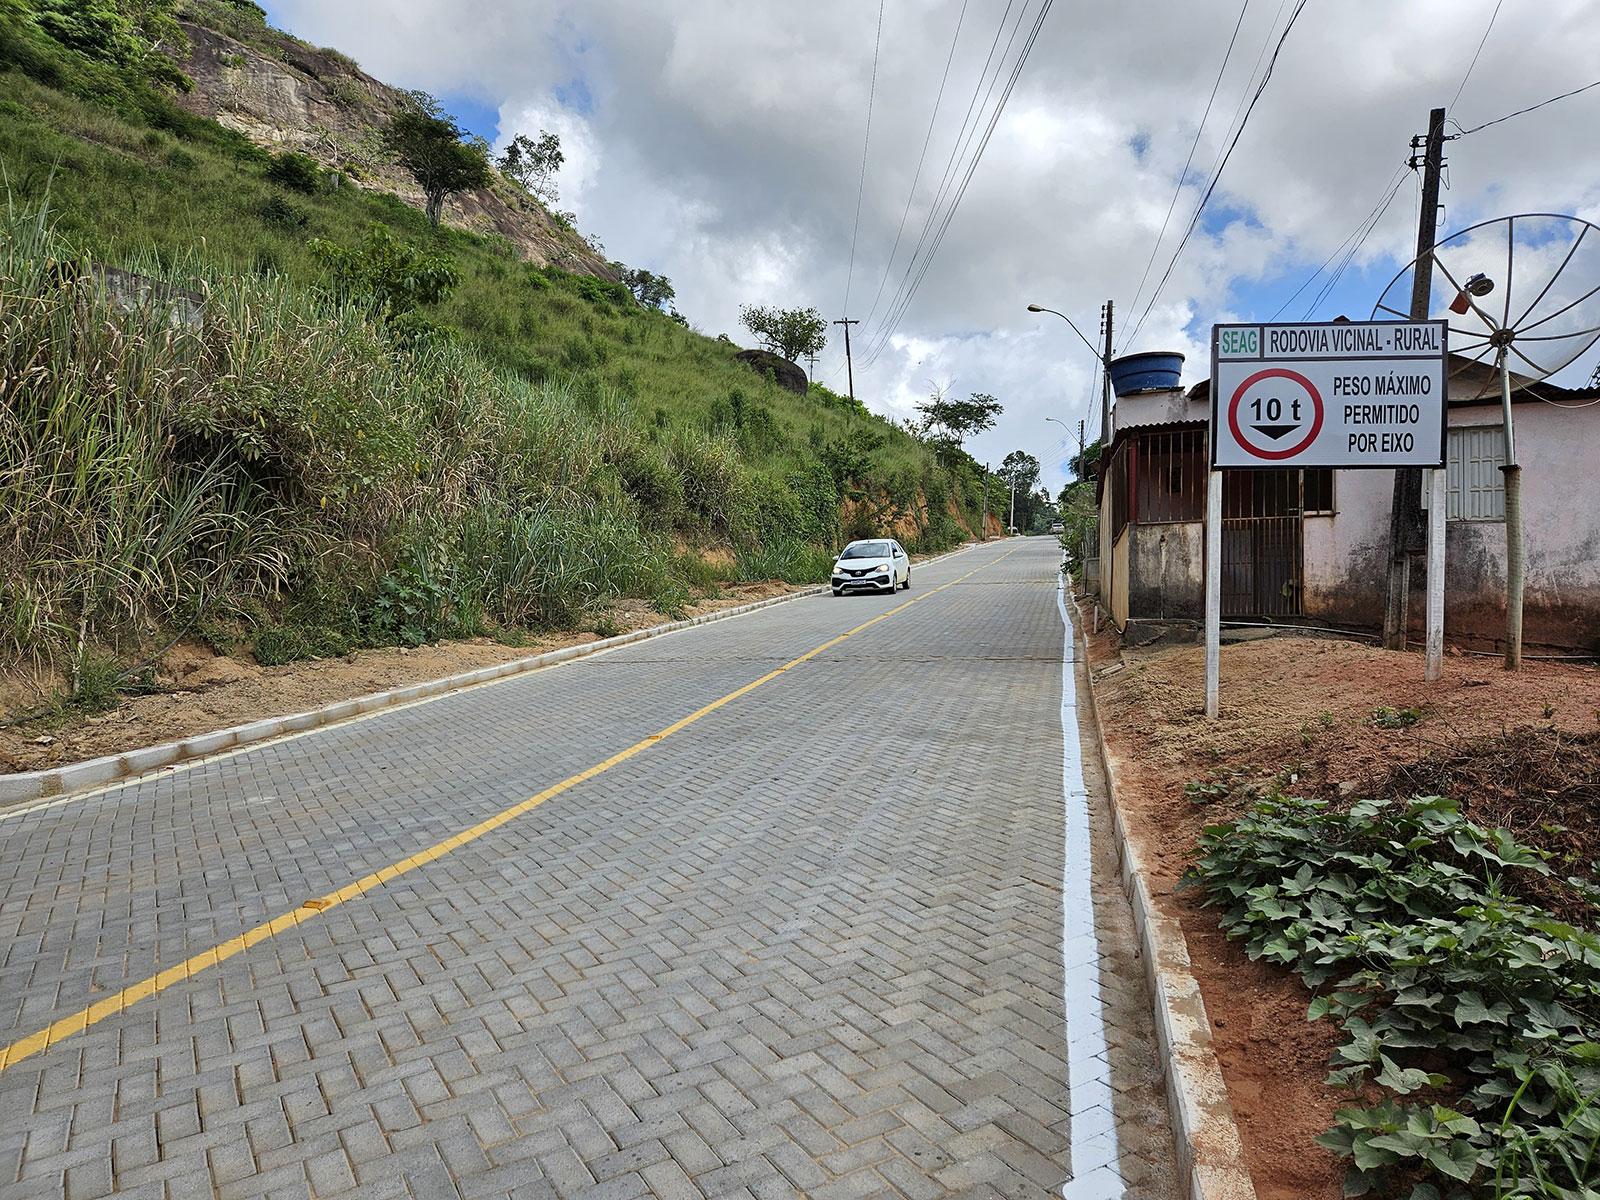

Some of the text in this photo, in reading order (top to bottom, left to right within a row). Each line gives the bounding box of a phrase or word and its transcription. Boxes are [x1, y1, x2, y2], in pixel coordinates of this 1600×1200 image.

[1222, 330, 1257, 354] SEAG
[1270, 329, 1329, 353] RODOVIA
[1331, 328, 1383, 352] VICINAL
[1394, 327, 1439, 351] RURAL
[1333, 370, 1431, 396] PESO MÁXIMO
[1250, 398, 1301, 422] 10 t
[1344, 404, 1420, 425] PERMITIDO
[1349, 432, 1414, 453] POR EIXO
